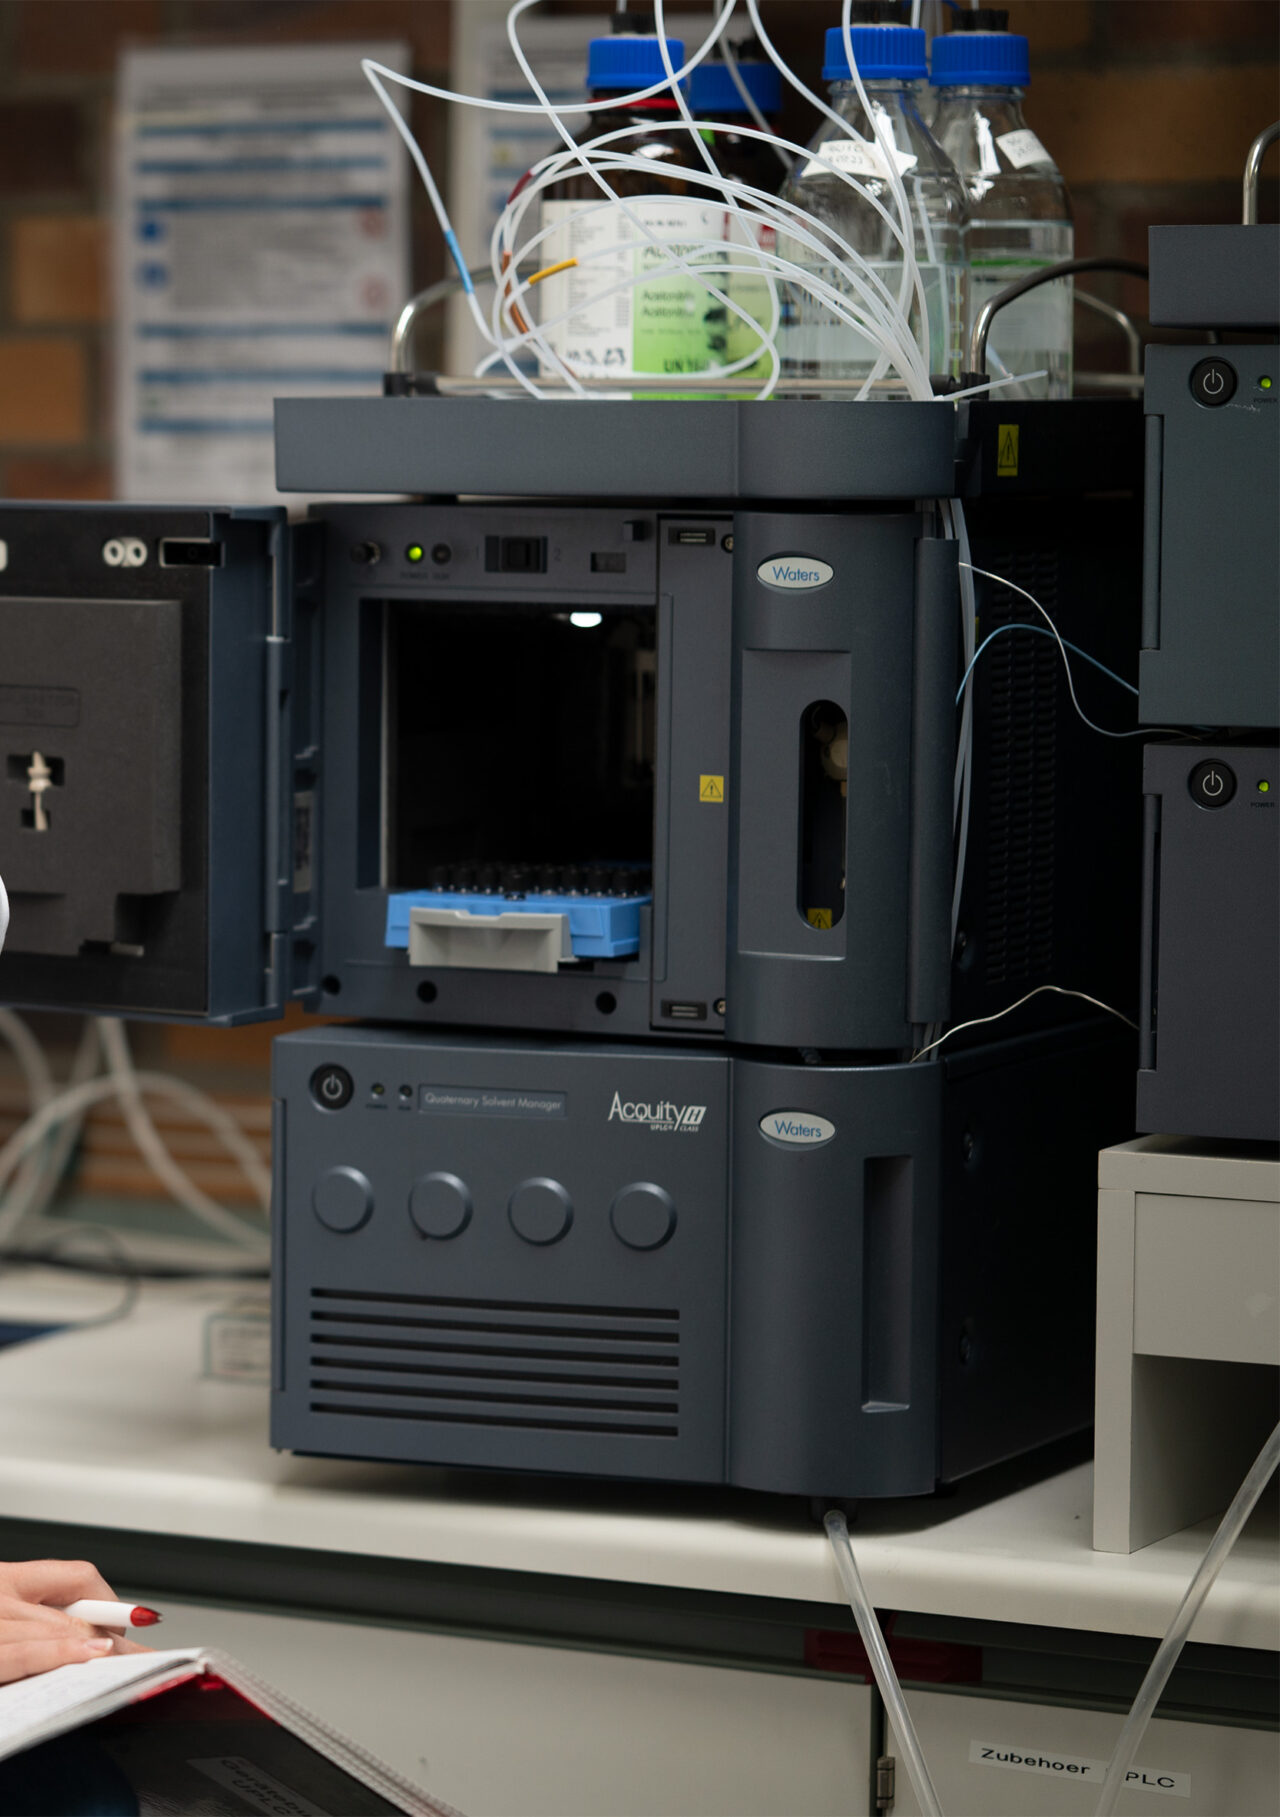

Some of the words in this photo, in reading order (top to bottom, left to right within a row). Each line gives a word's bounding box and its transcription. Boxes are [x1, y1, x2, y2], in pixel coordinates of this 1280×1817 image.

[772, 566, 820, 582] Waters
[424, 1092, 478, 1109] Quaternary
[481, 1095, 516, 1108] Solvent
[517, 1097, 562, 1112] Manager
[774, 1119, 822, 1138] Waters
[981, 1747, 1090, 1775] Zubehoer
